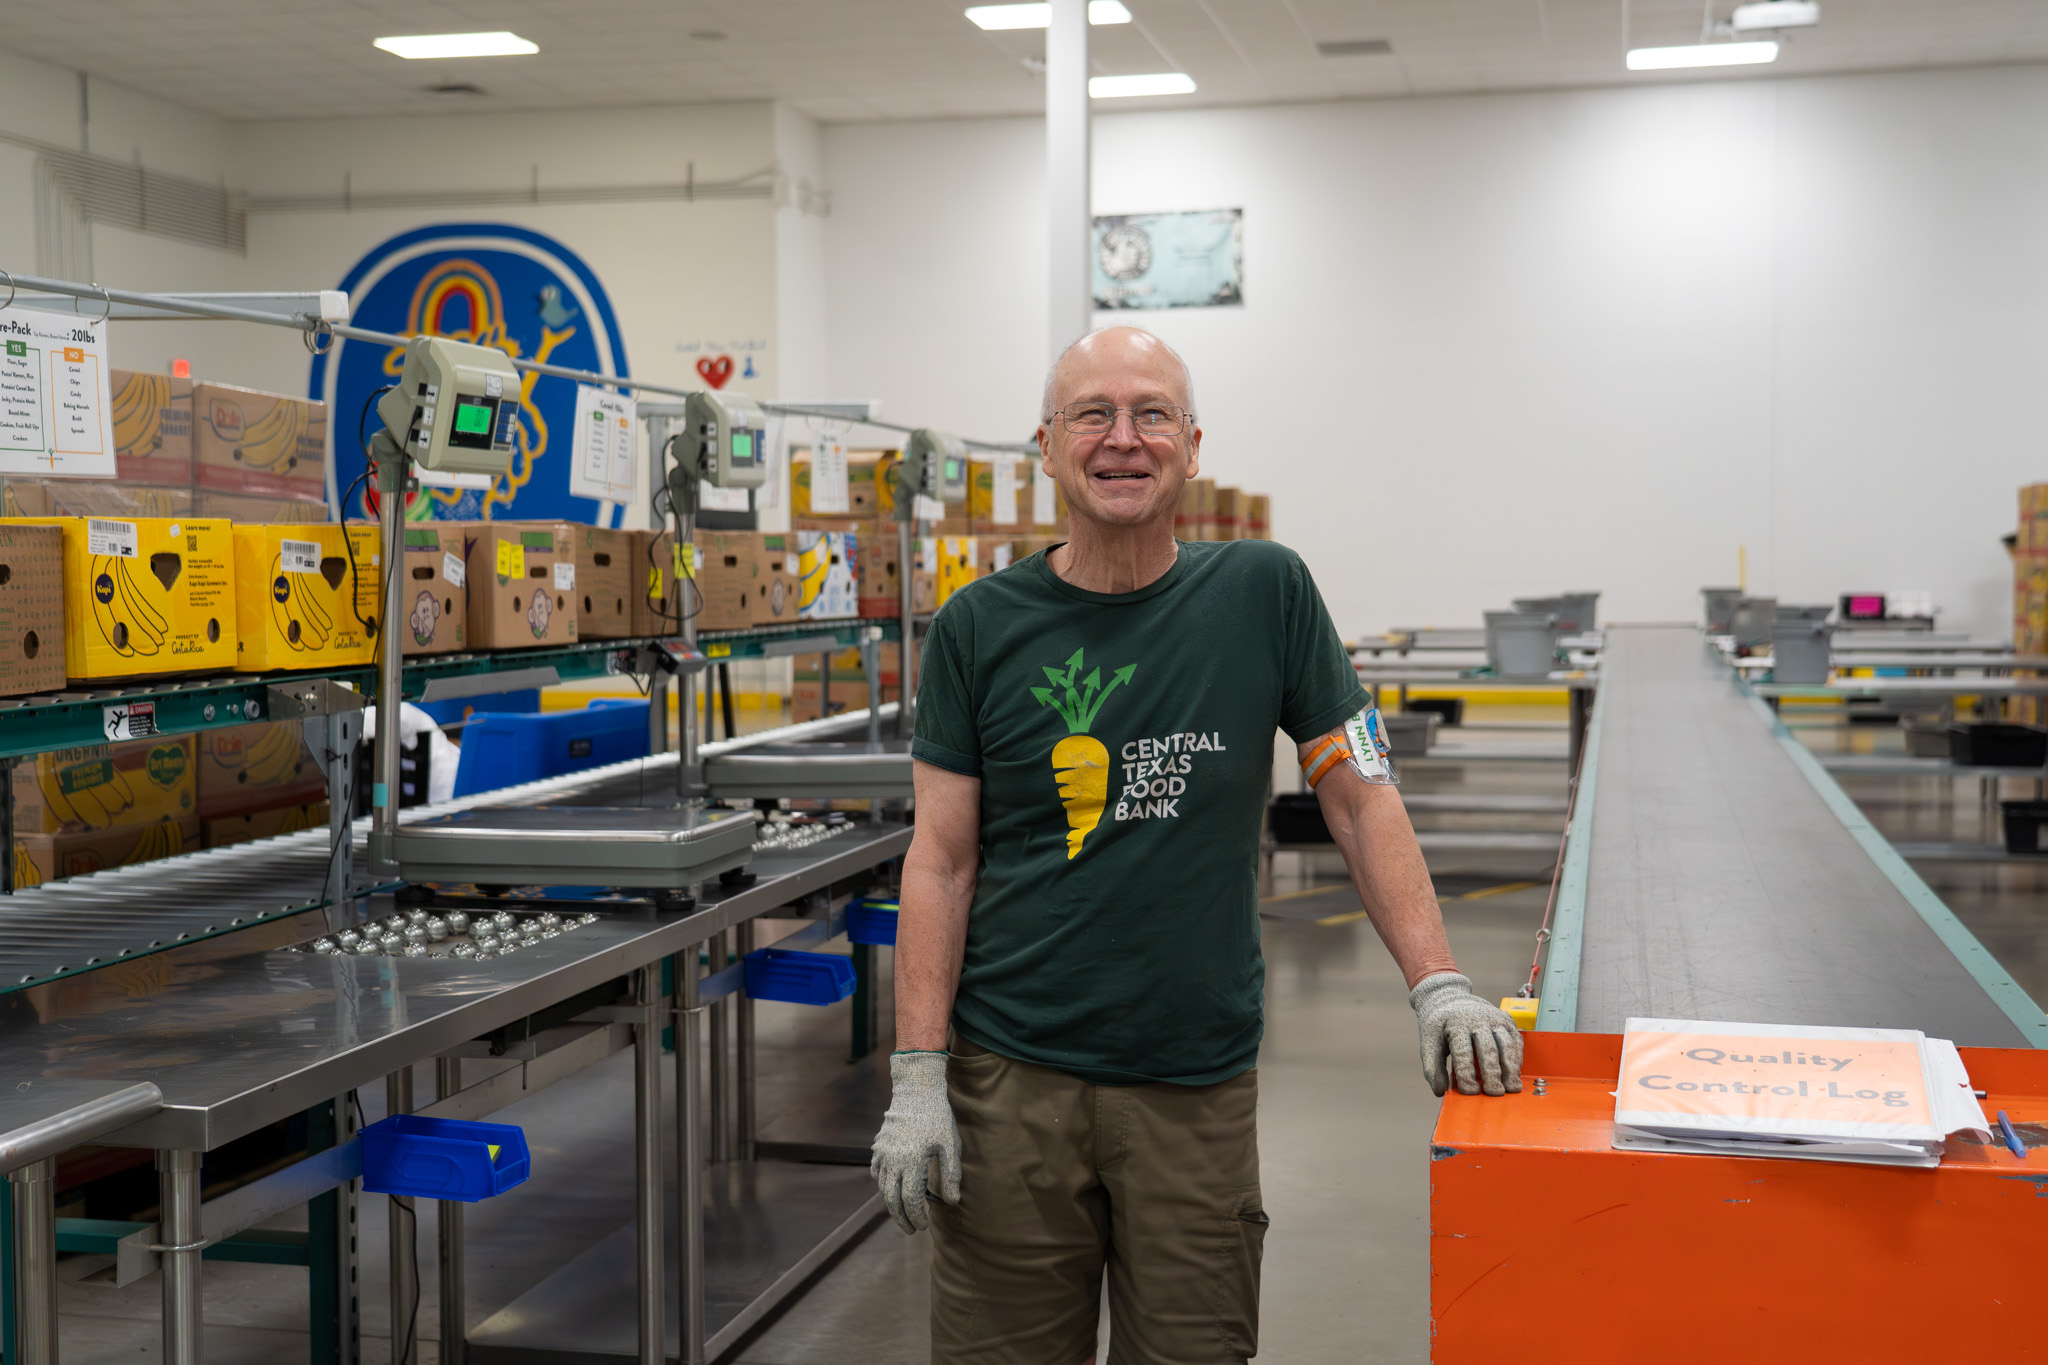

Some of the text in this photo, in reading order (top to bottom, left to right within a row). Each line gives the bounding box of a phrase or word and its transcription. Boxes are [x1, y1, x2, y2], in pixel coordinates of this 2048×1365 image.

[72, 329, 95, 344] 20lbs
[11, 344, 22, 353] YES
[69, 351, 79, 360] NO
[97, 584, 111, 596] Kapi
[275, 585, 288, 596] Kapi
[135, 704, 153, 714] DANGER
[1122, 732, 1226, 761] CENTRAL
[1355, 725, 1374, 762] LYNN
[1122, 754, 1192, 783] TEXAS
[1120, 777, 1186, 801] FOOD
[1115, 799, 1179, 821] BANK
[1686, 1047, 1854, 1072] Quality
[1638, 1074, 1910, 1107] Control Log
